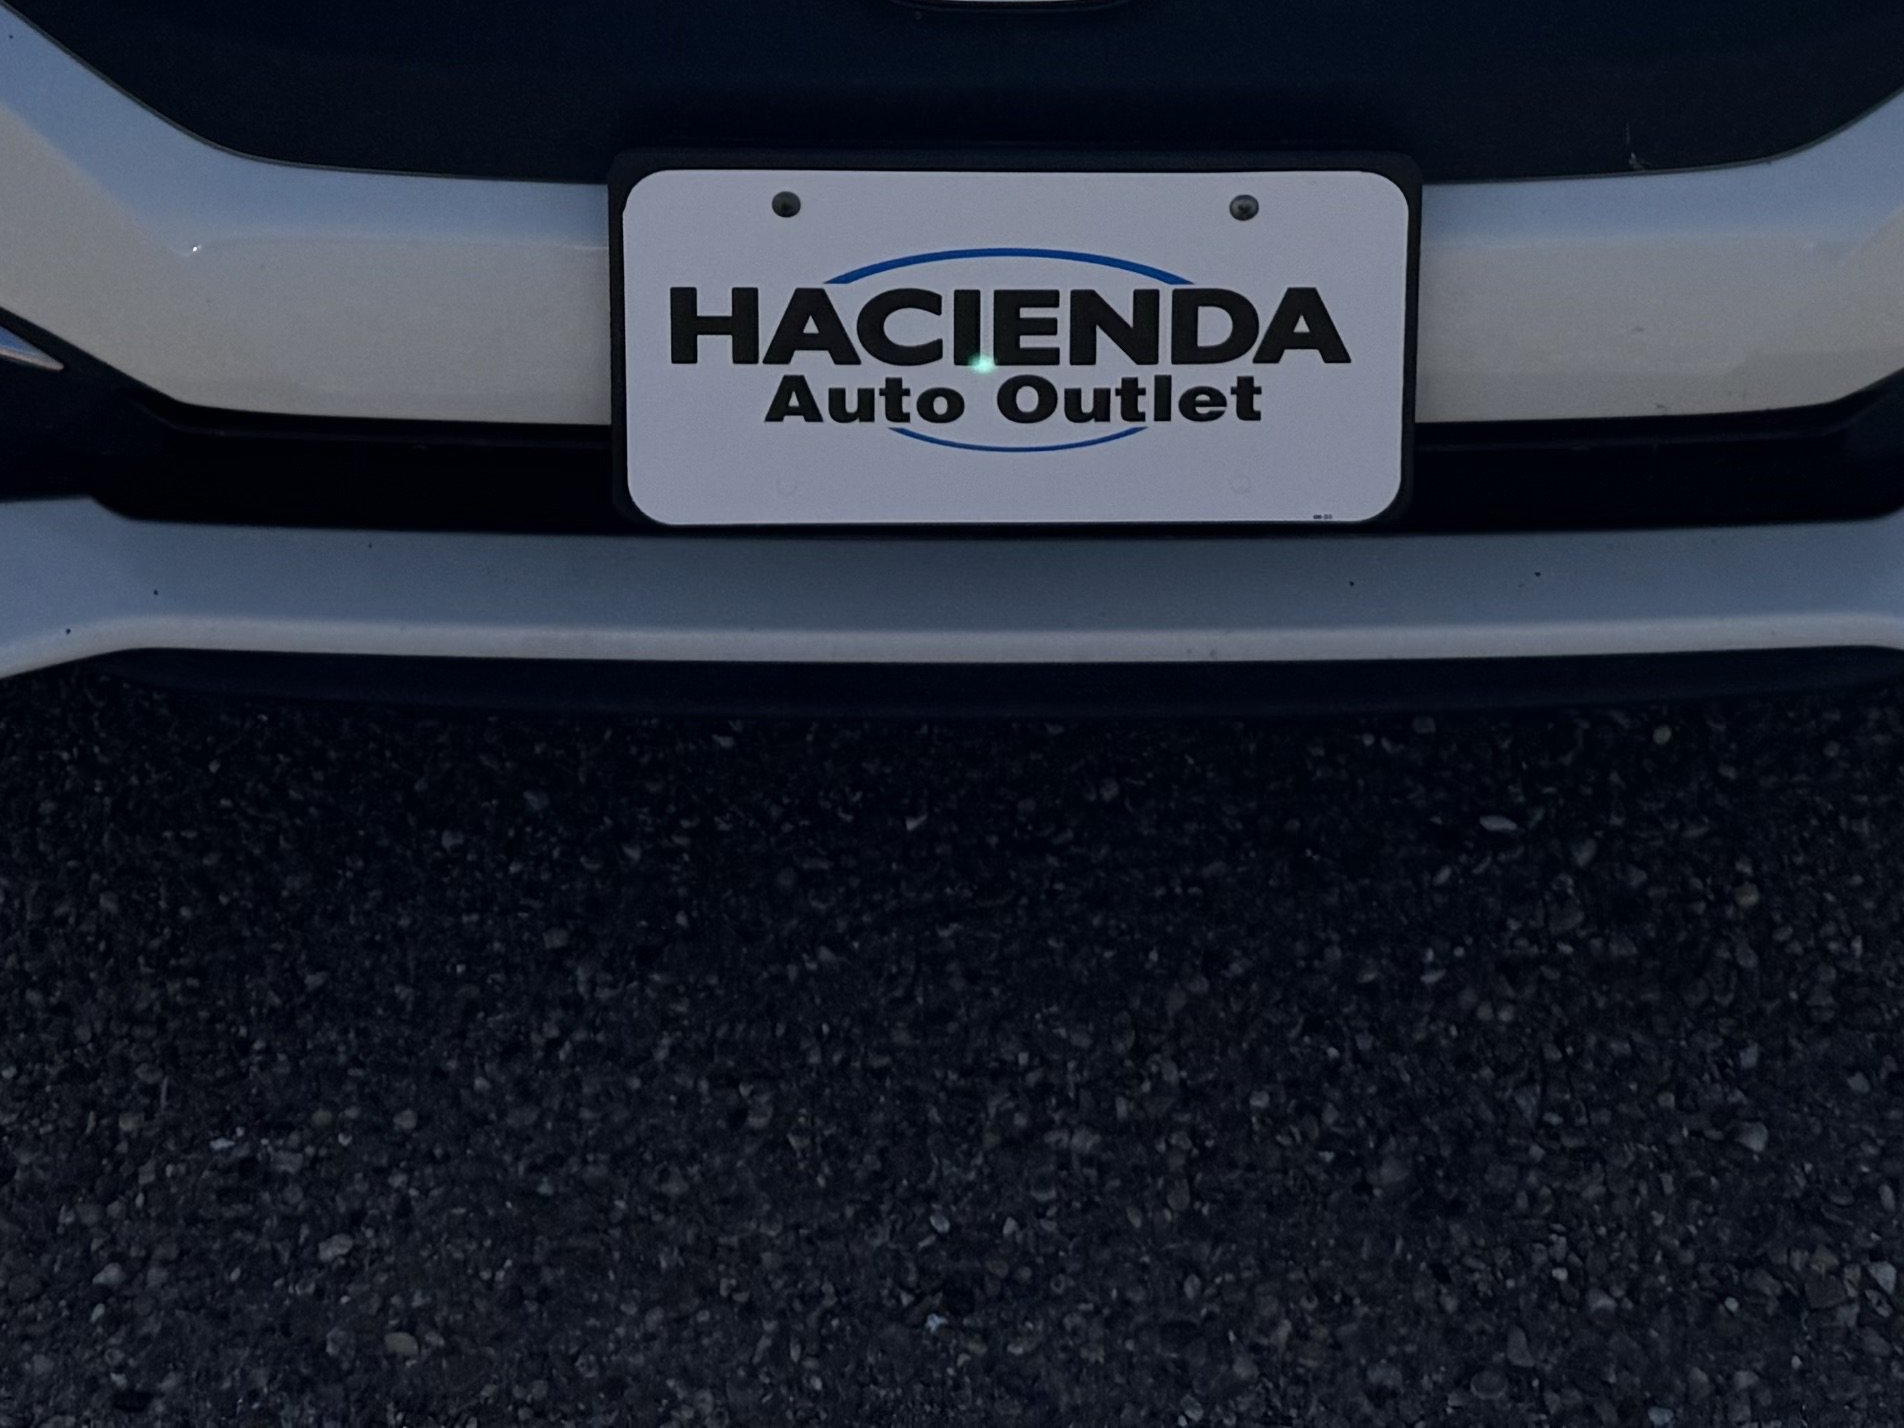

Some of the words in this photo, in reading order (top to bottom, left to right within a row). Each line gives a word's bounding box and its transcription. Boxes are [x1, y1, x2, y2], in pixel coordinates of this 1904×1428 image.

[669, 285, 1352, 366] HACIENDA
[764, 374, 966, 424] Auto
[995, 373, 1263, 424] Outlet
